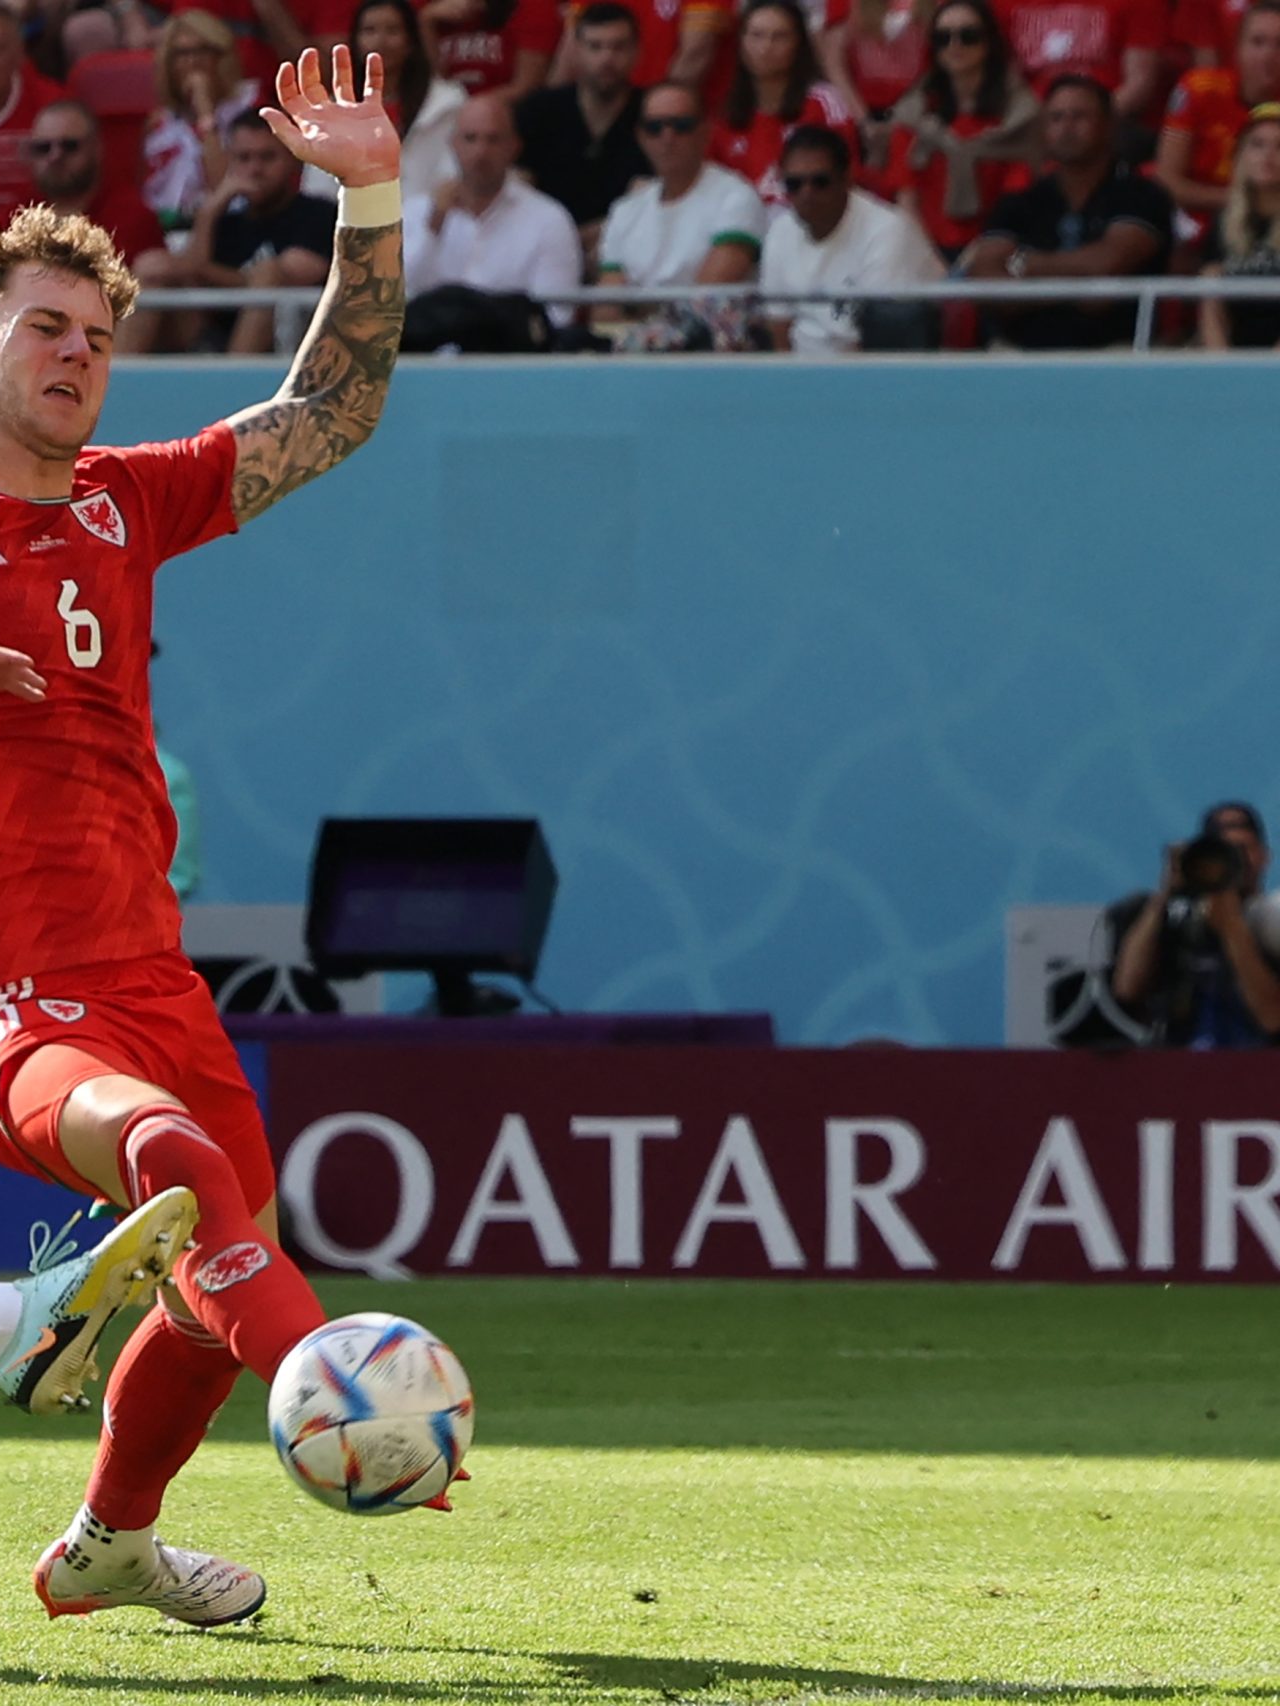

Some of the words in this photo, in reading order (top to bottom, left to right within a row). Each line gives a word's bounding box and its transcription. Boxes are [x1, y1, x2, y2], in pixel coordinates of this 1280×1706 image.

[57, 579, 103, 669] 6
[278, 1110, 937, 1282] QATAR
[991, 1115, 1280, 1271] AIR
